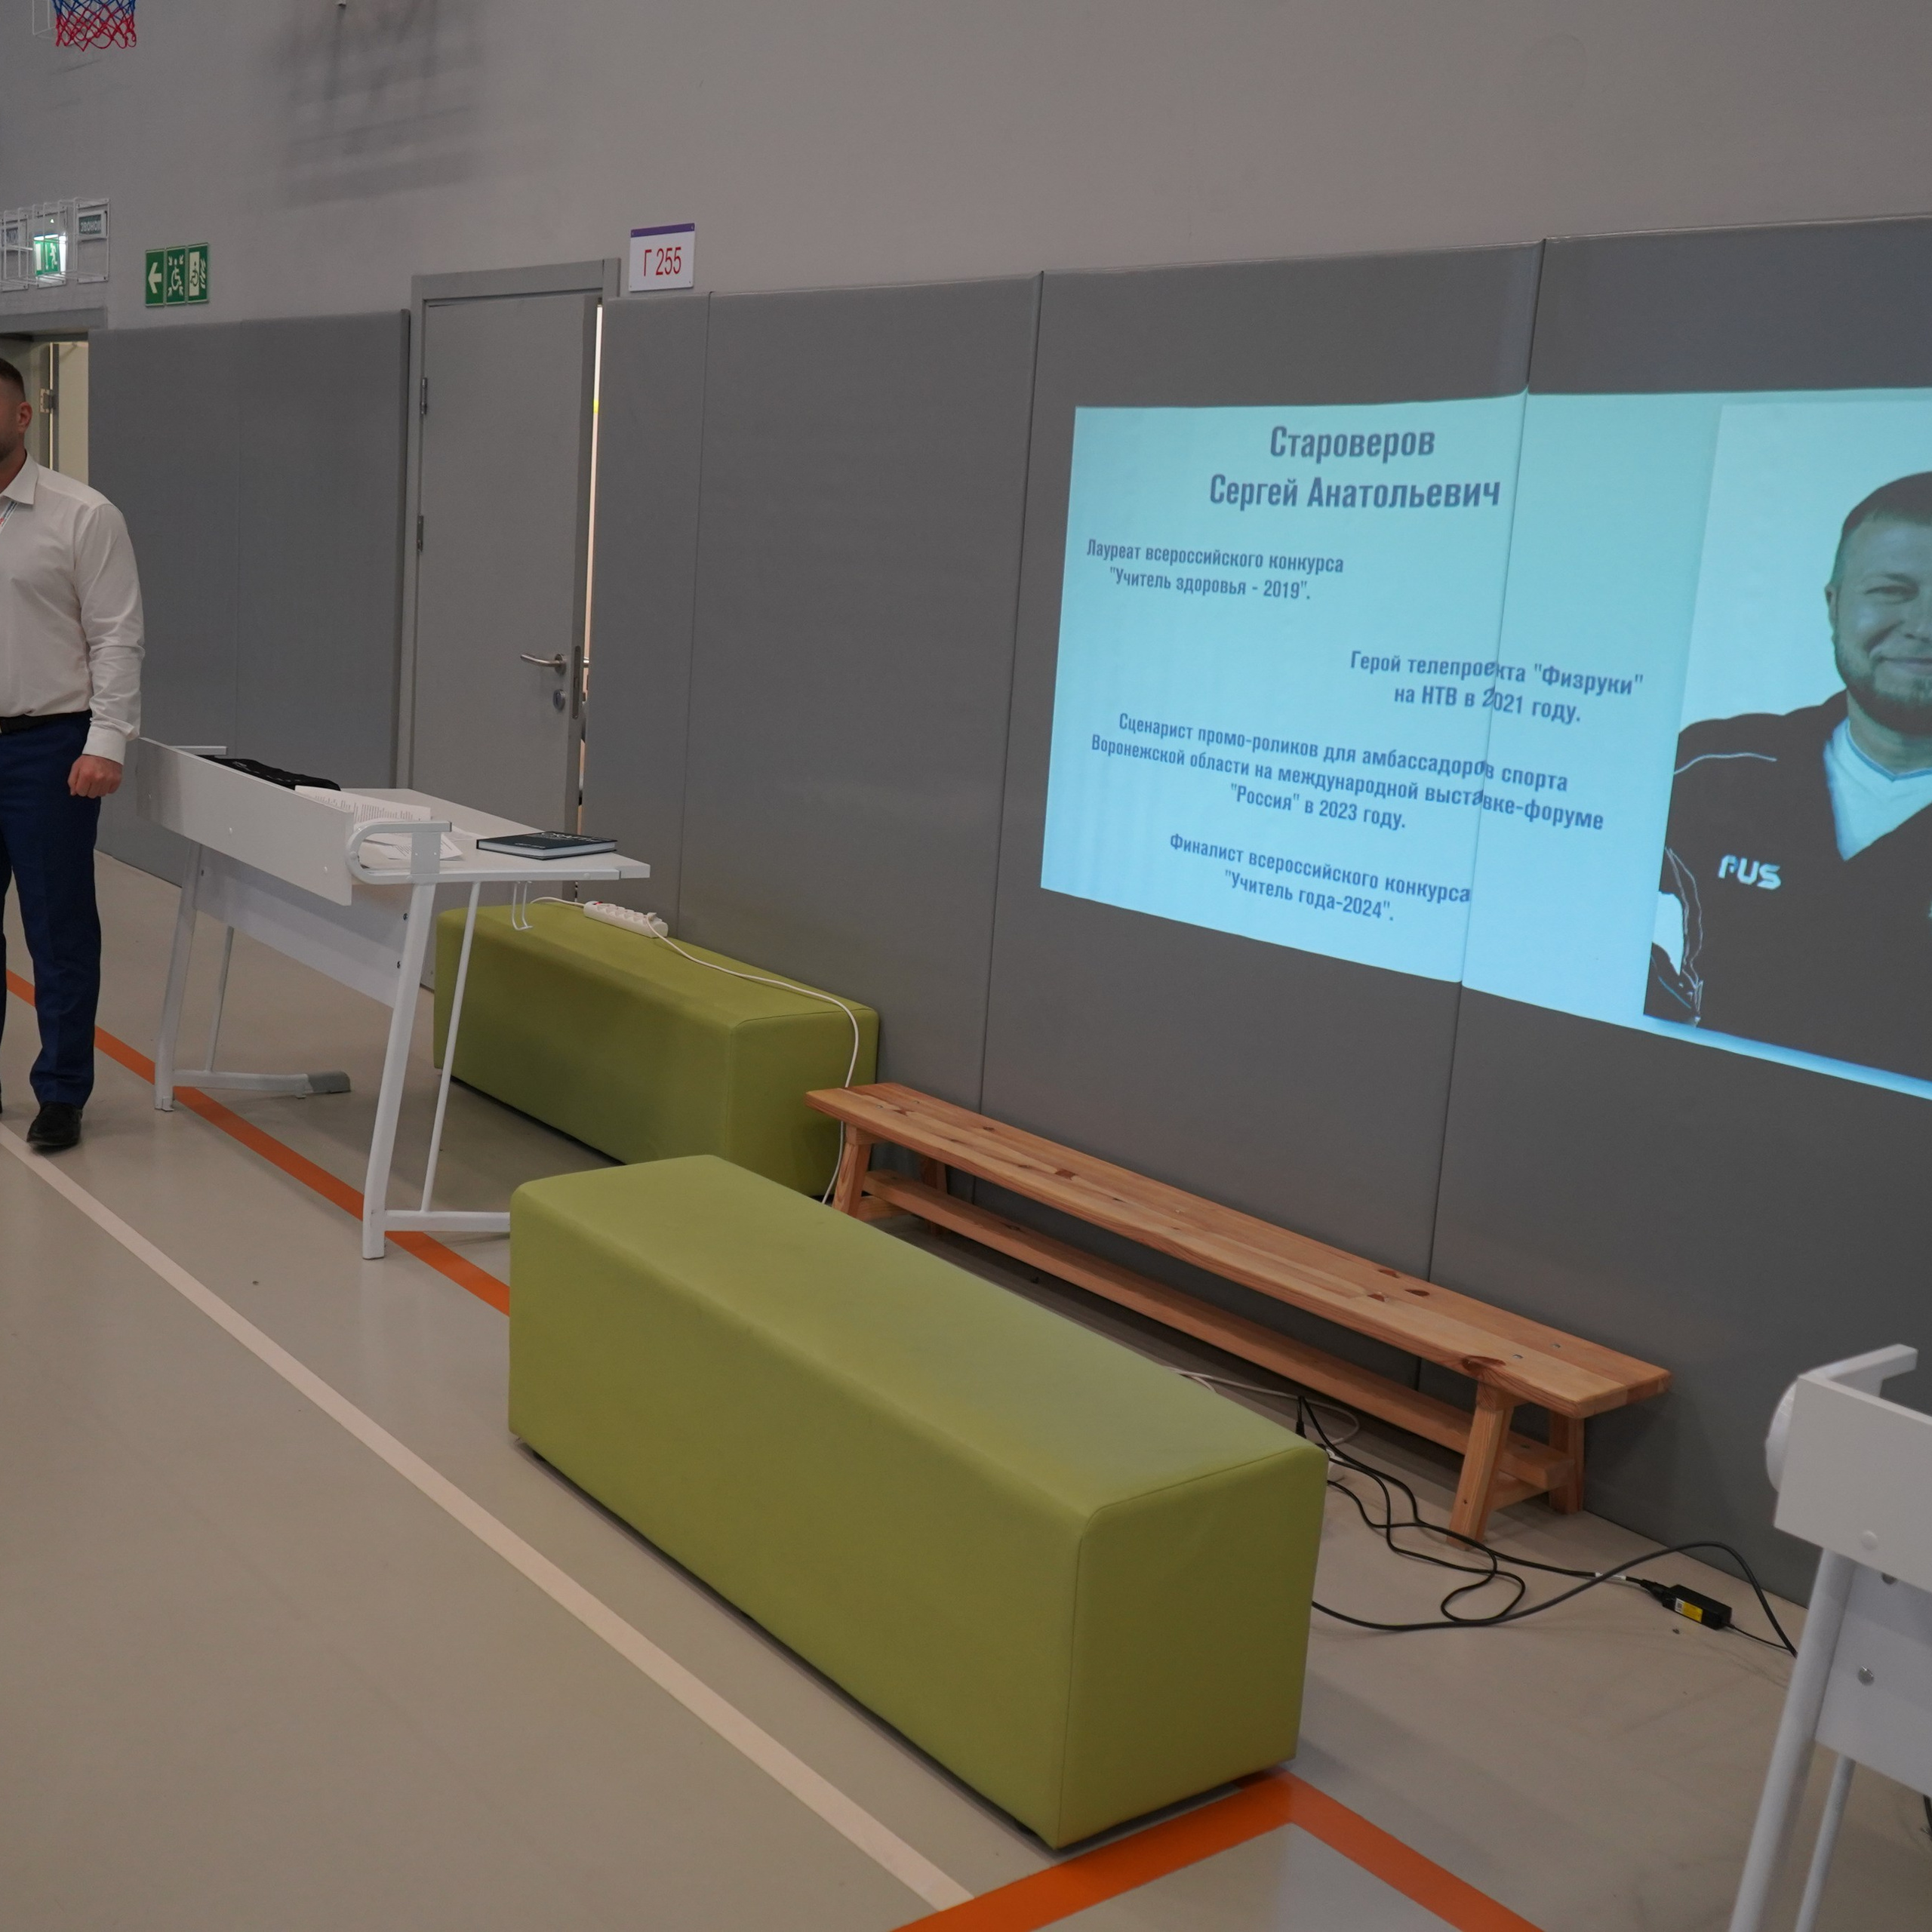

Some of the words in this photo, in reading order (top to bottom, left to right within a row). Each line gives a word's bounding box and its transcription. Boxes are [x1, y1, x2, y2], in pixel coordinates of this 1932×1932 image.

[644, 249, 652, 276] Г
[656, 246, 681, 275] 255
[1270, 426, 1435, 465] Староверов
[1211, 474, 1297, 512] Сергей
[1306, 477, 1500, 509] Анатольевич
[1087, 539, 1141, 561] Лауреат
[1146, 548, 1263, 568] всероссийского
[1269, 555, 1343, 575] конкурса
[1110, 567, 1171, 589] "Учитель
[1177, 577, 1246, 596] здоровья
[1263, 580, 1310, 599] 2019".
[1351, 651, 1401, 675] Герой
[1407, 660, 1525, 682] телепроекта
[1534, 663, 1643, 697] "Физруки"
[1394, 688, 1414, 703] на
[1422, 685, 1457, 706] НТВ
[1464, 693, 1475, 707] в
[1482, 688, 1523, 715] 2021
[1532, 702, 1580, 725] году.
[1119, 713, 1193, 740] Сценарист
[1198, 729, 1318, 758] промо-роликов
[1323, 746, 1356, 764] для
[1362, 749, 1494, 779] амбассадоров
[1501, 768, 1567, 792] спорта
[1092, 734, 1185, 765] Воронежской
[1190, 752, 1249, 776] области
[1255, 764, 1272, 780] на
[1278, 768, 1418, 801] международной
[1425, 787, 1603, 830] выставке-форуме
[1231, 783, 1300, 811] "Россия"
[1305, 800, 1314, 814] в
[1319, 800, 1357, 822] 2023
[1364, 809, 1405, 832] году.
[1171, 833, 1244, 863] Финалист
[1249, 852, 1378, 889] всероссийского
[1385, 877, 1471, 904] конкурса
[1226, 869, 1293, 900] "Учитель
[1299, 890, 1393, 921] года-2024".
